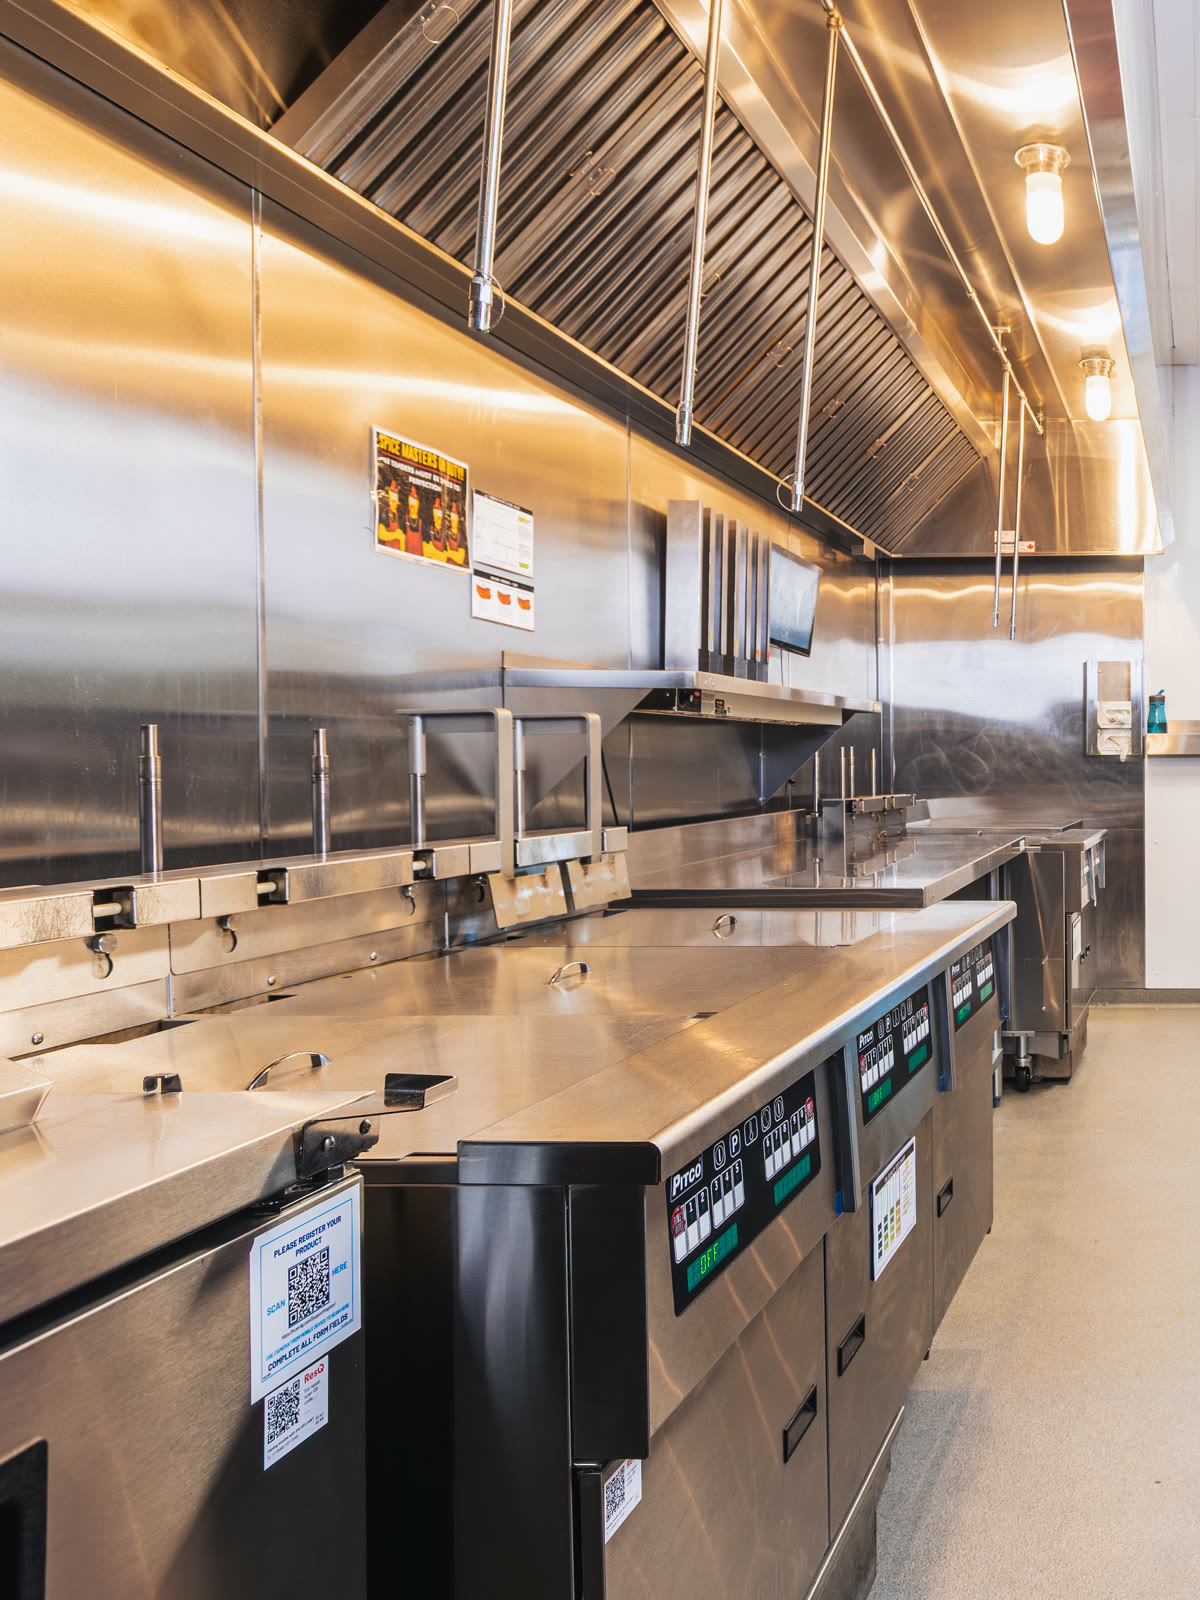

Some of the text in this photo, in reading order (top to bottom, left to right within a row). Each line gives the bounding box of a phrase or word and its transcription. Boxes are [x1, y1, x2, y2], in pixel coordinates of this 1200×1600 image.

[379, 433, 400, 456] SPICE
[401, 442, 438, 469] MASTERS
[415, 469, 432, 480] MUST
[672, 1162, 702, 1197] PITCO
[689, 1202, 694, 1213] 1
[700, 1191, 705, 1203] 2
[714, 1180, 719, 1191] 3
[724, 1171, 729, 1182] 4
[735, 1162, 740, 1174] 5
[775, 1130, 778, 1140] 7
[273, 1215, 342, 1258] PLEASE REGISTER YOUR
[295, 1236, 322, 1257] PRODUCT
[332, 1261, 348, 1276] HERE
[700, 1242, 718, 1275] OFF
[266, 1299, 286, 1316] SCAN
[267, 1313, 349, 1372] COMPLETE ALL FORM FIELDS
[273, 1342, 290, 1356] CAMERA
[300, 1326, 314, 1338] MOBILE
[314, 1318, 326, 1330] DEVICE
[304, 1363, 325, 1384] ResQ
